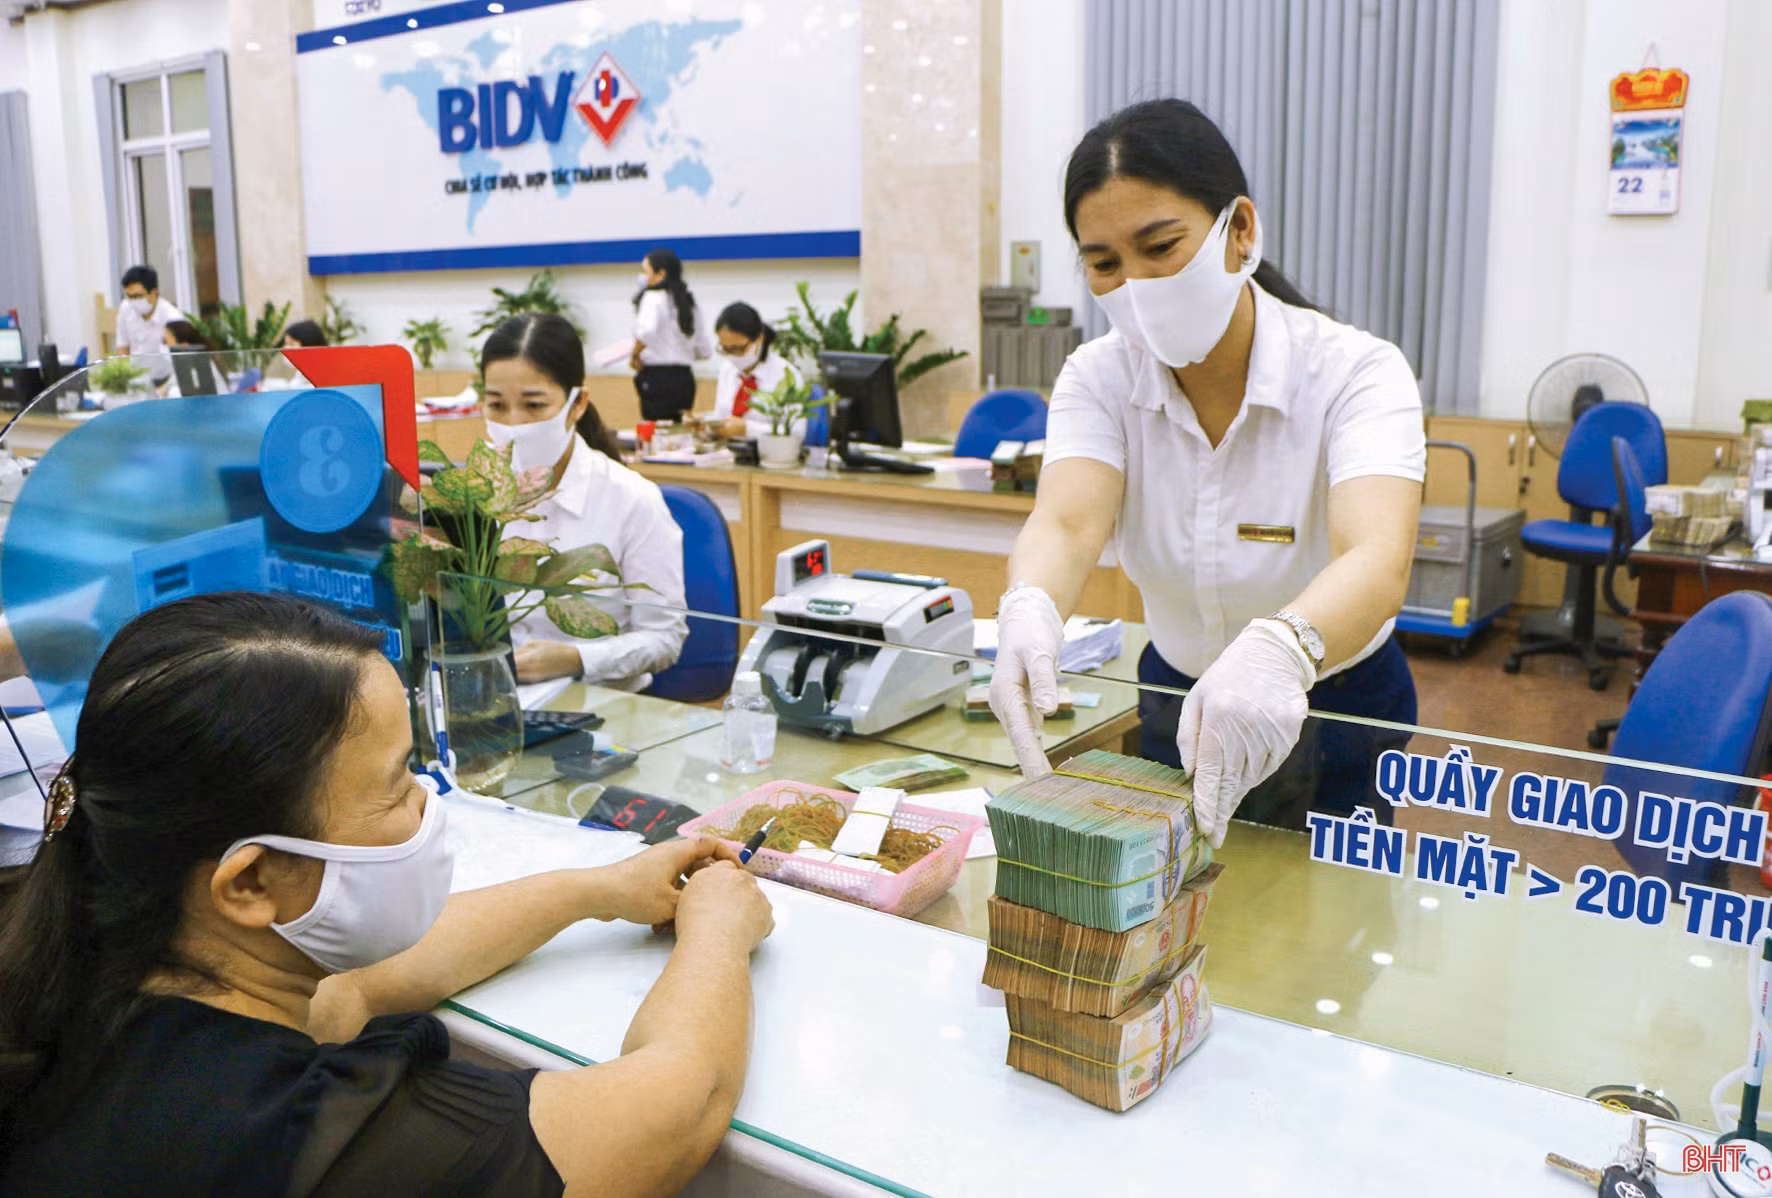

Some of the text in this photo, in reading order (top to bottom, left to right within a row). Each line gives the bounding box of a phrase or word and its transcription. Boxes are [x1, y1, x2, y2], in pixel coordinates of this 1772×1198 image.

[437, 71, 575, 153] BIDV
[1618, 177, 1643, 194] 22
[1379, 746, 1765, 863] QUẦY GIAO DỊCH
[1309, 809, 1404, 876] TIỀN
[1415, 833, 1517, 900] MẶT
[1528, 867, 1562, 898] >
[1575, 867, 1669, 926] 200
